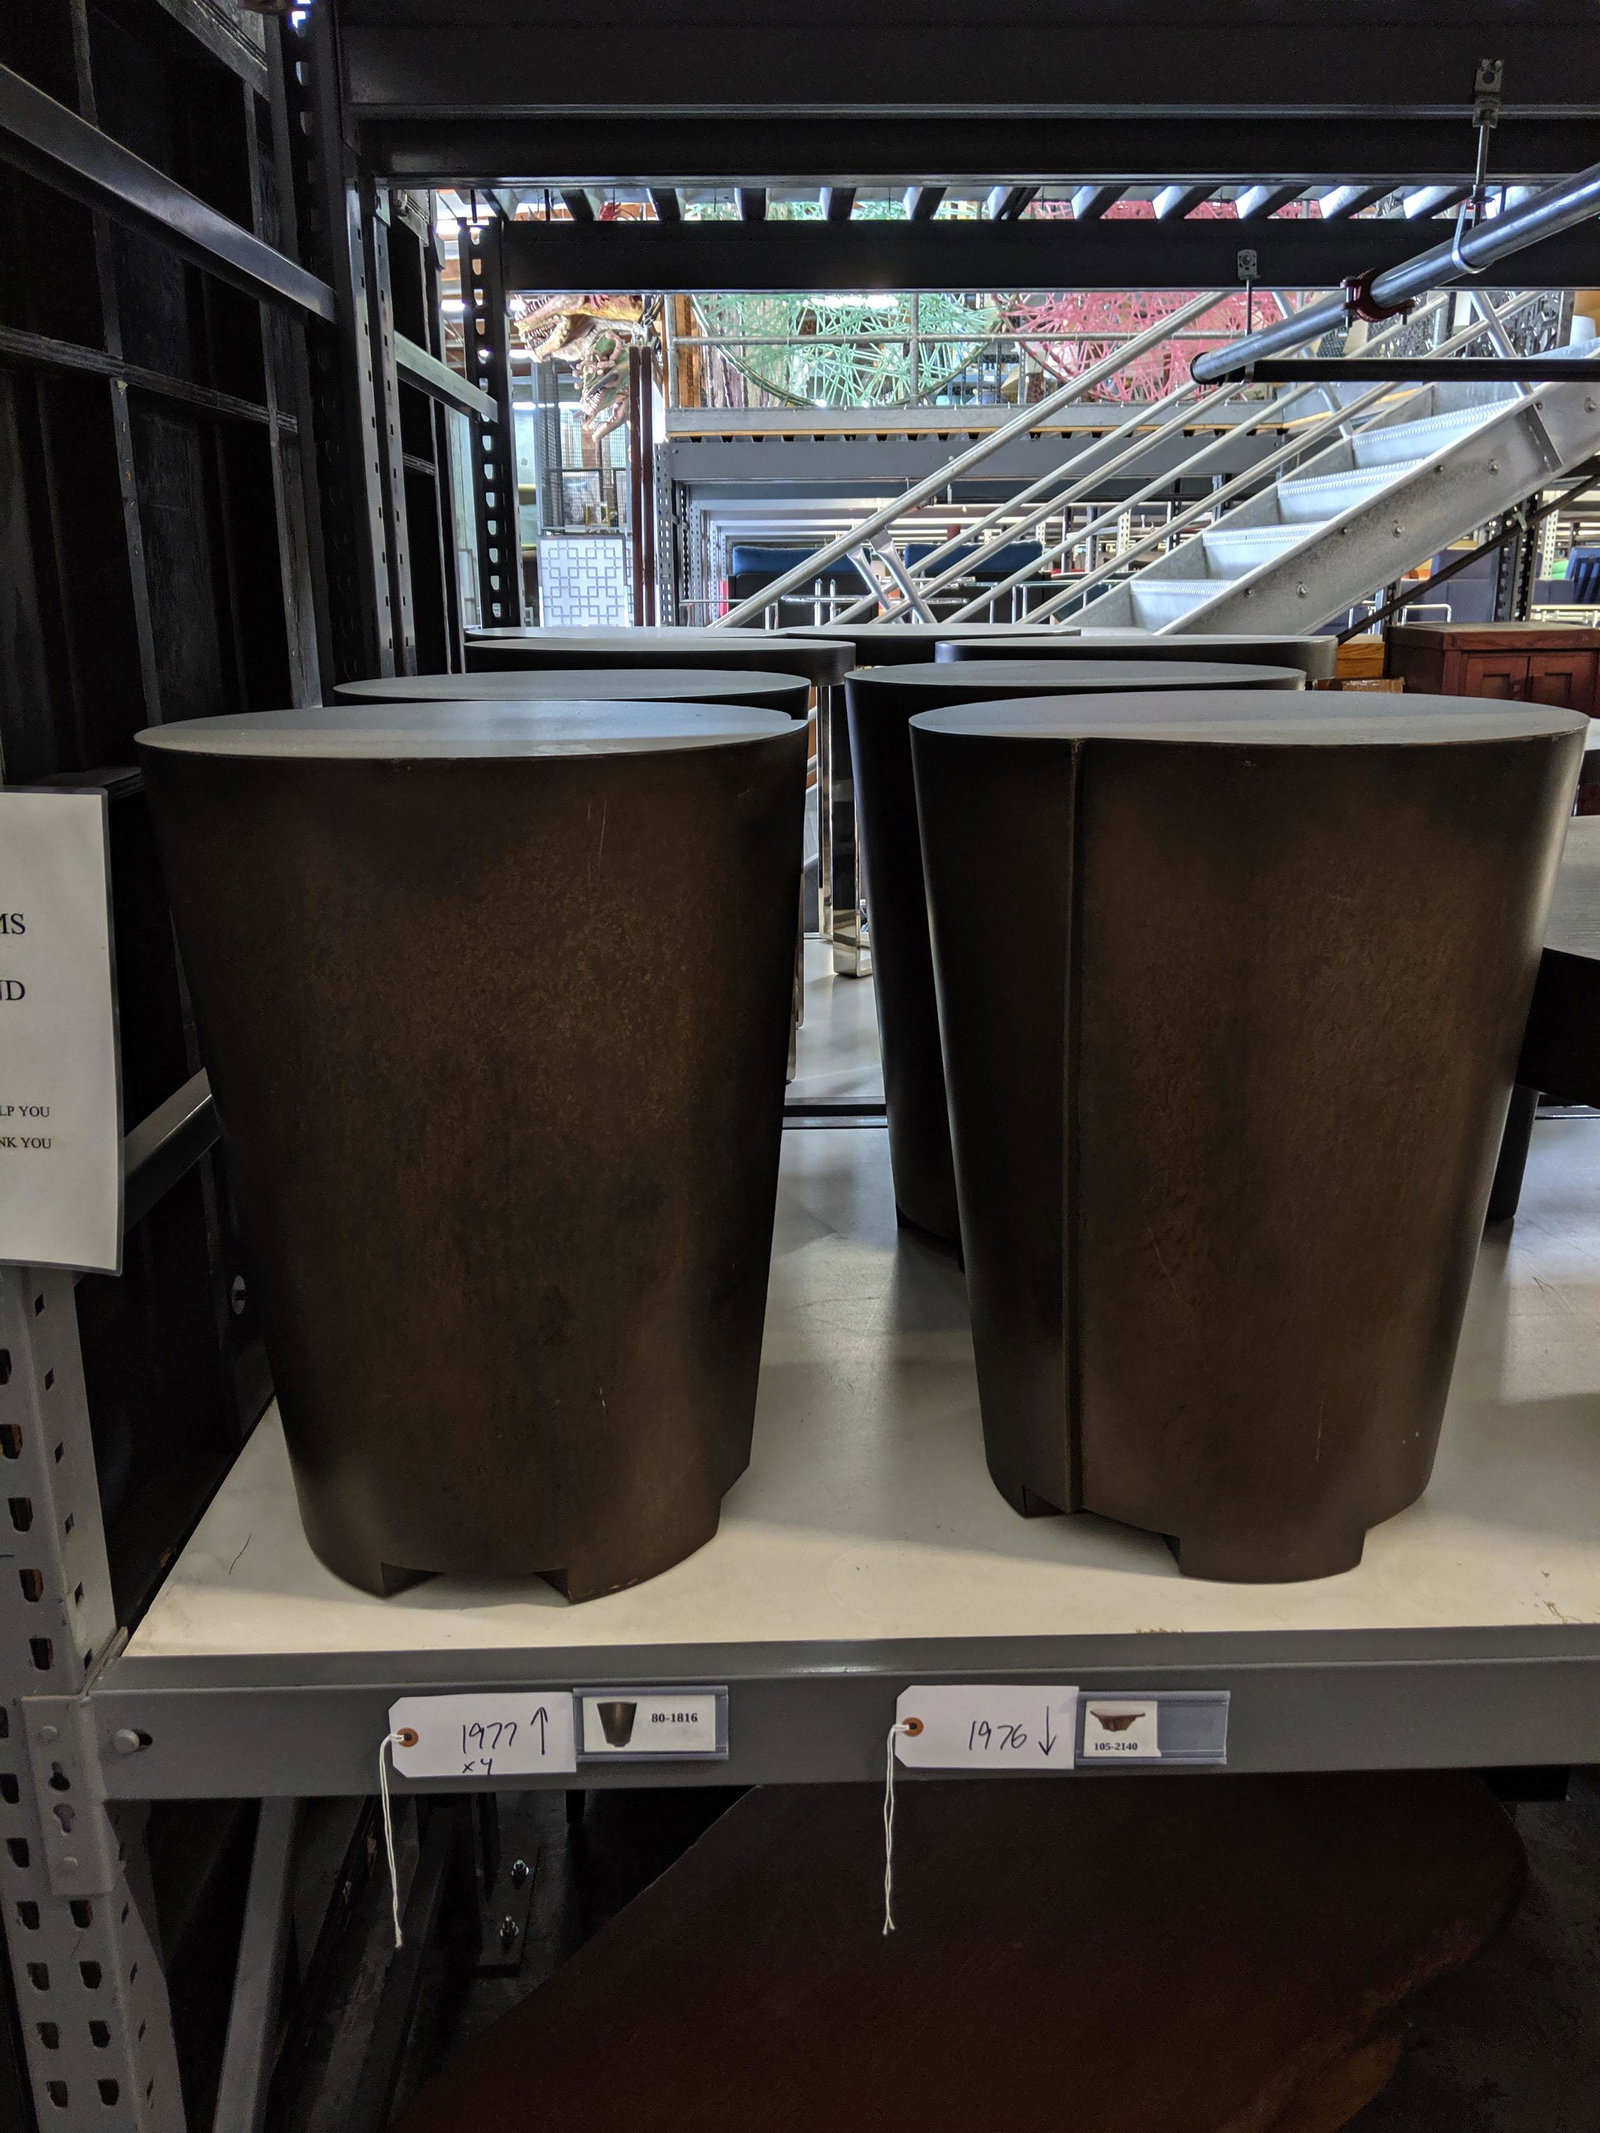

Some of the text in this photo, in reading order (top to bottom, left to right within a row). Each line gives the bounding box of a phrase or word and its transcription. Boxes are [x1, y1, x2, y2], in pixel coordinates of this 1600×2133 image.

[18, 1105, 50, 1118] YOU
[20, 1137, 52, 1149] YOU
[651, 1712, 699, 1724] 80-1816
[462, 1722, 518, 1754] 1977
[968, 1720, 1028, 1751] 1976
[1093, 1741, 1139, 1752] 105-2140
